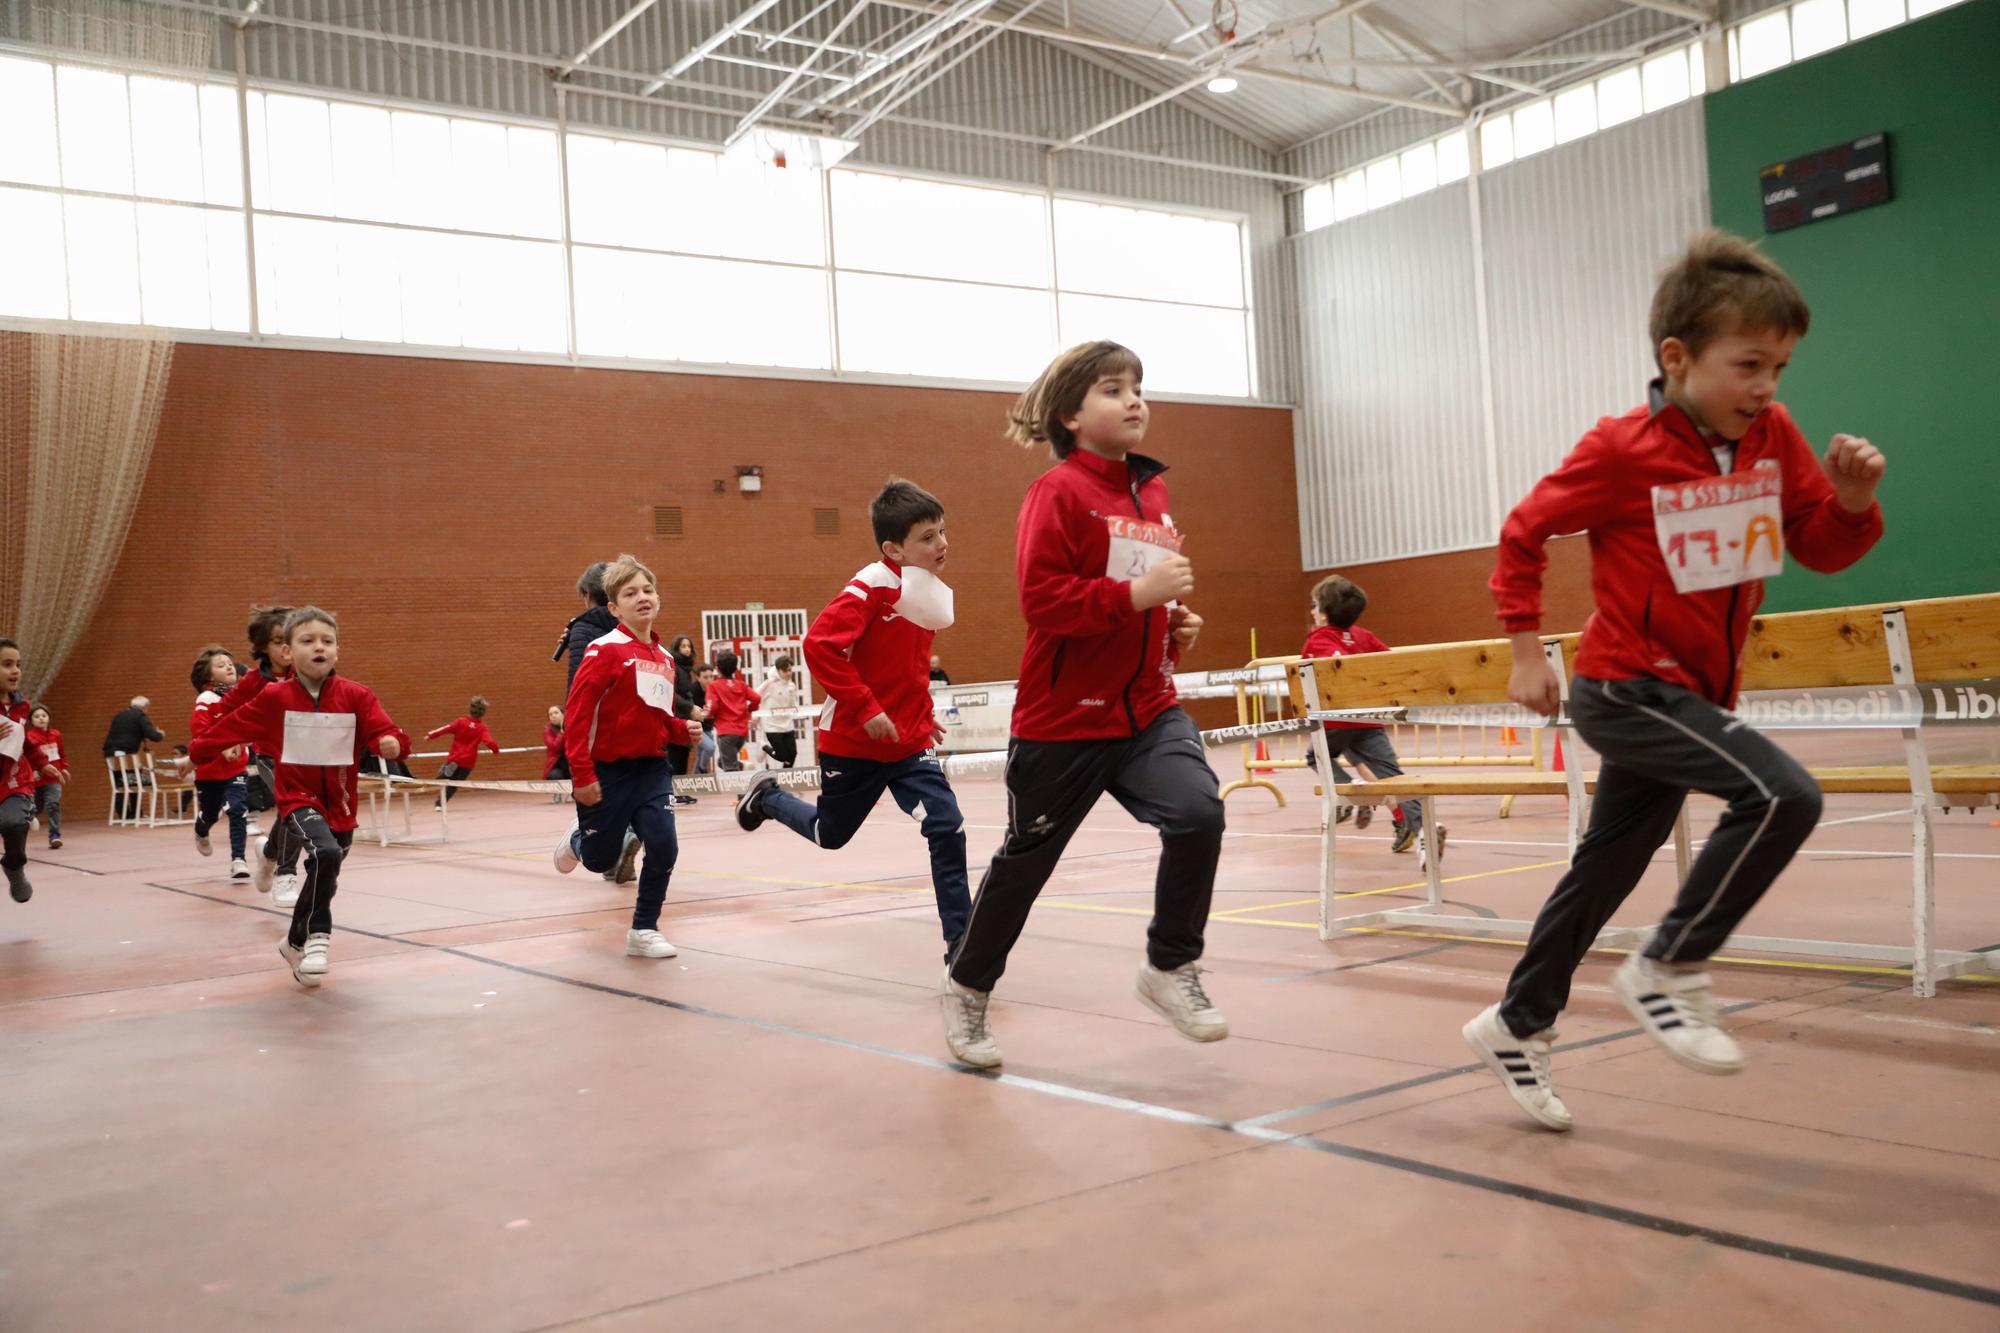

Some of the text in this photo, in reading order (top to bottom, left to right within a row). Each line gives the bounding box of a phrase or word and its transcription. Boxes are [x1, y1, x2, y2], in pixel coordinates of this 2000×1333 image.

[1764, 187, 1798, 205] LOCAL
[1209, 669, 1257, 684] Liberbank
[674, 776, 717, 792] Liberbank
